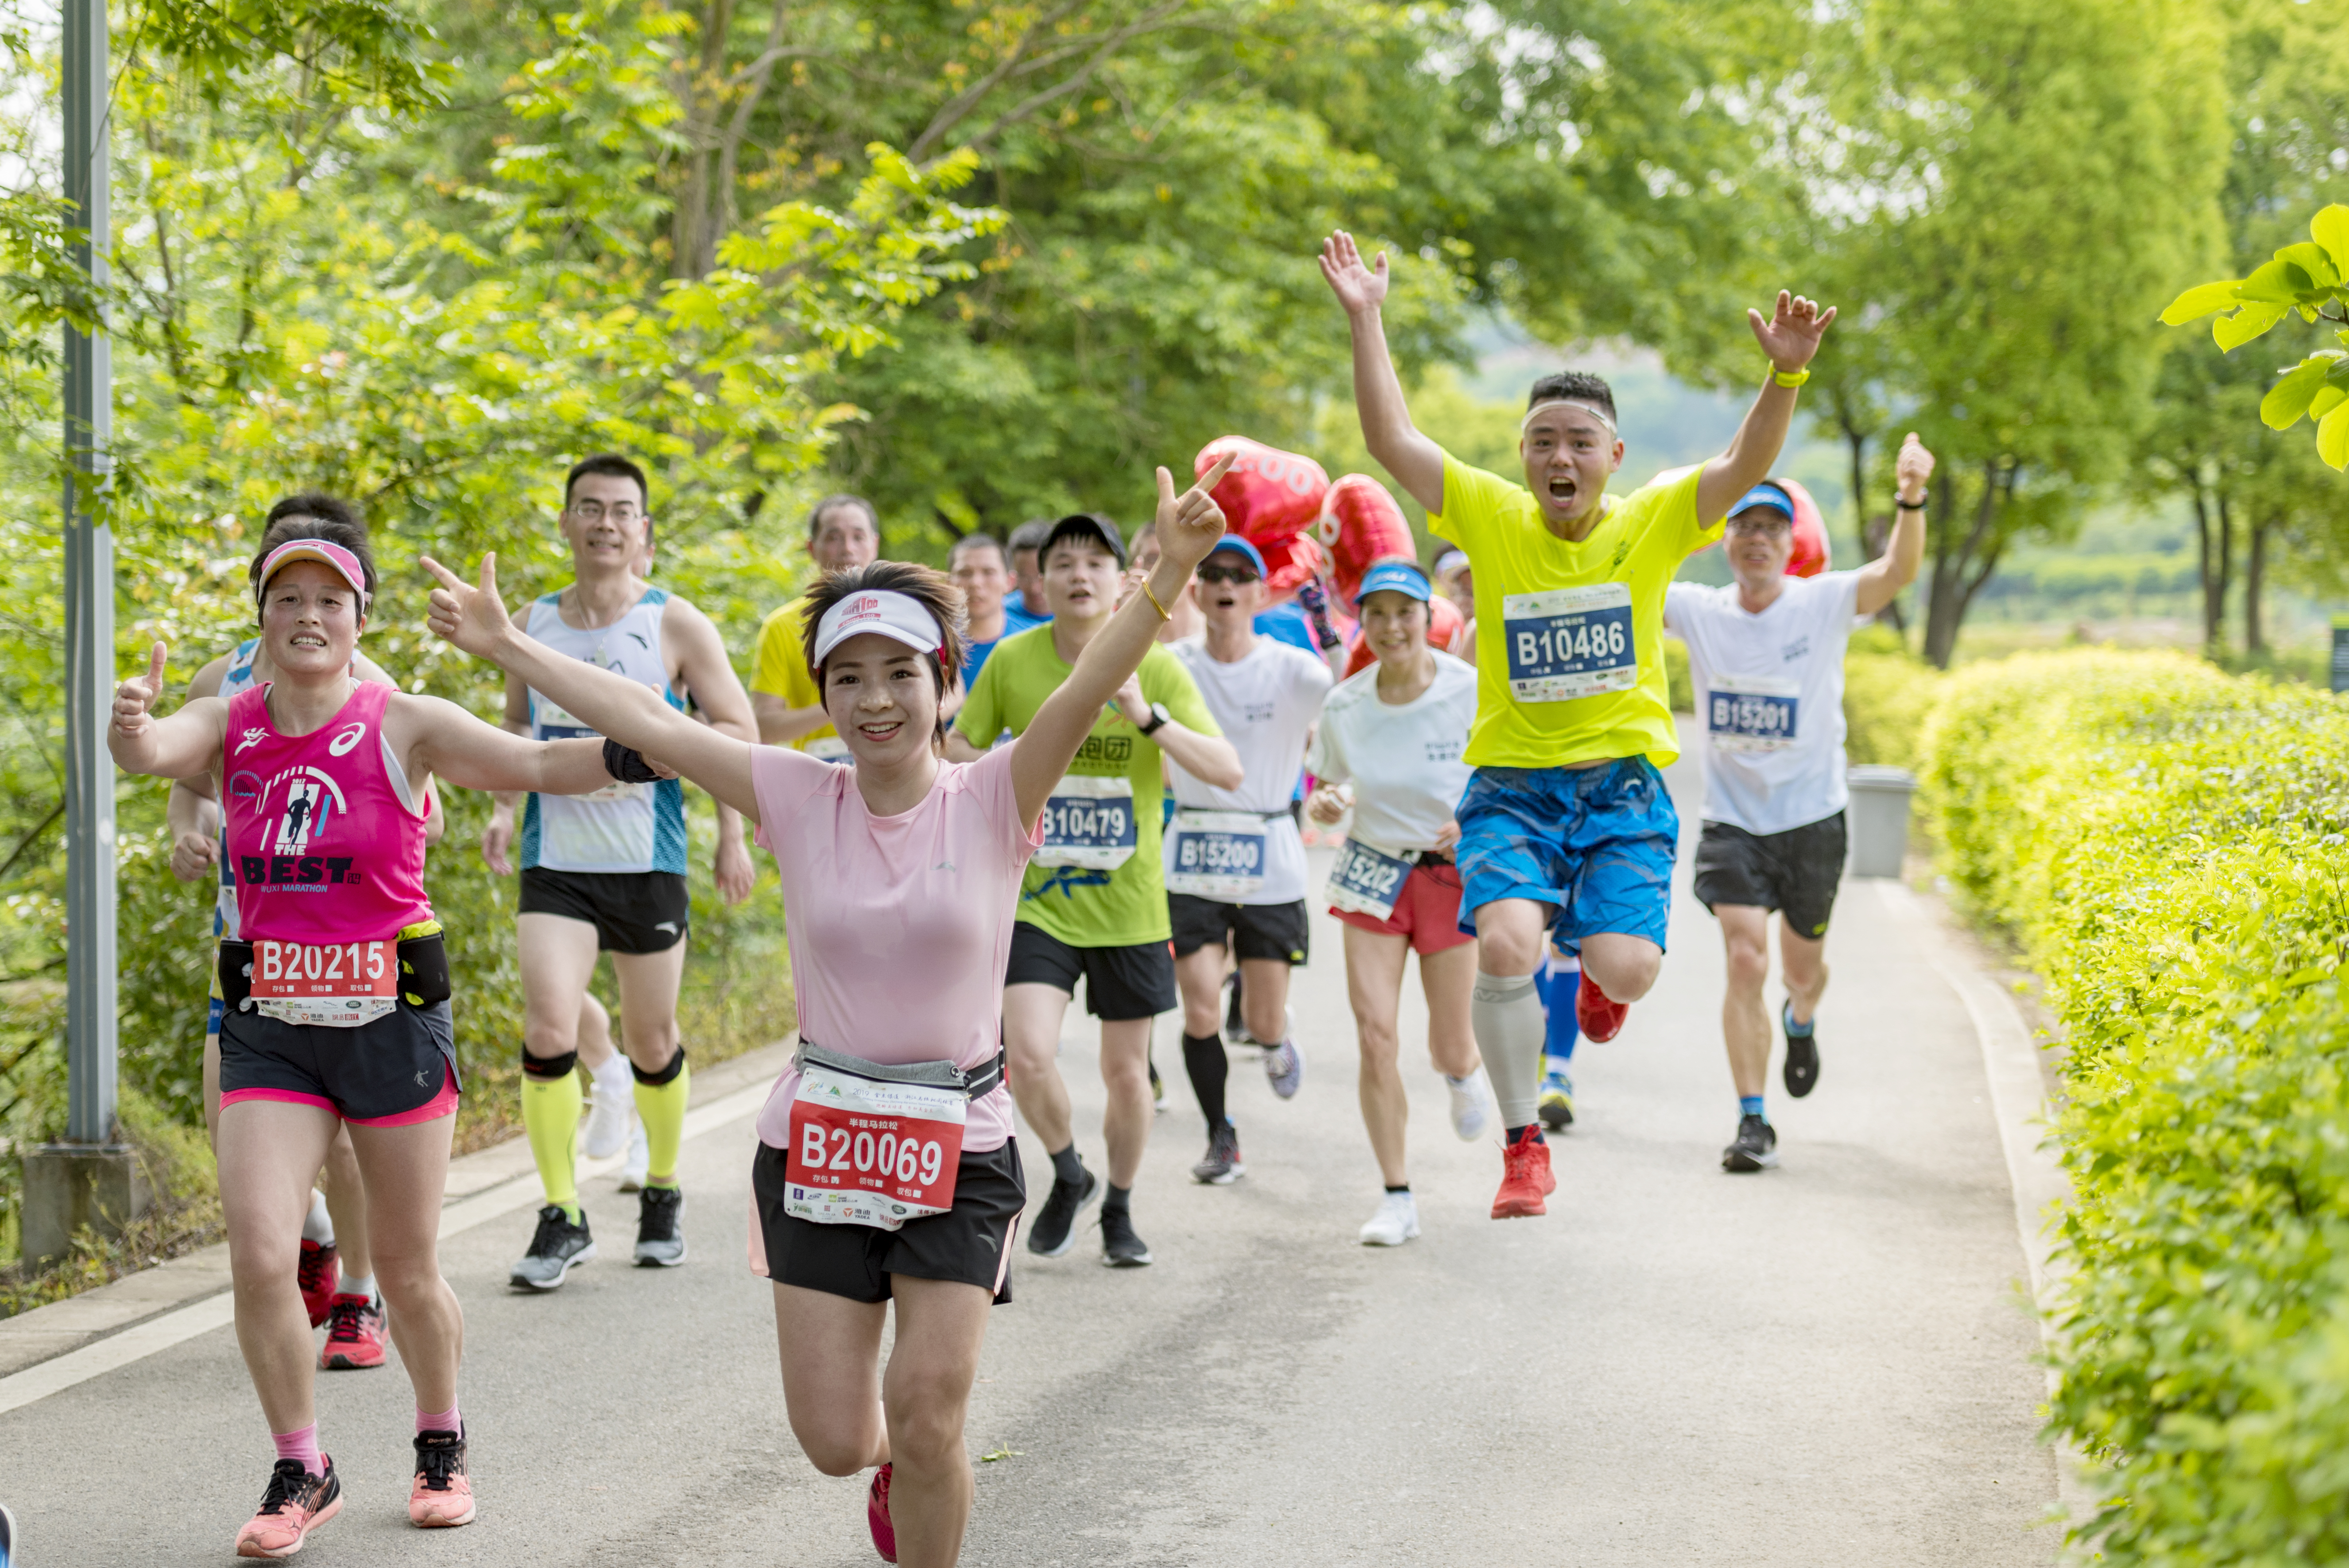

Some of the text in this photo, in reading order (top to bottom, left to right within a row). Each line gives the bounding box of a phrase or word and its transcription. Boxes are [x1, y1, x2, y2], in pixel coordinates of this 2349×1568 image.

[1517, 621, 1625, 666] B10486
[1714, 698, 1789, 731] B15201
[1044, 806, 1126, 837] B10479
[275, 844, 306, 855] THE
[1180, 838, 1259, 869] B15200
[241, 855, 353, 884] BEST
[263, 941, 384, 980] B20215
[849, 1118, 898, 1130] 半程马拉松
[801, 1123, 942, 1186] B20069
[813, 1175, 912, 1197] 存包 领物 取包
